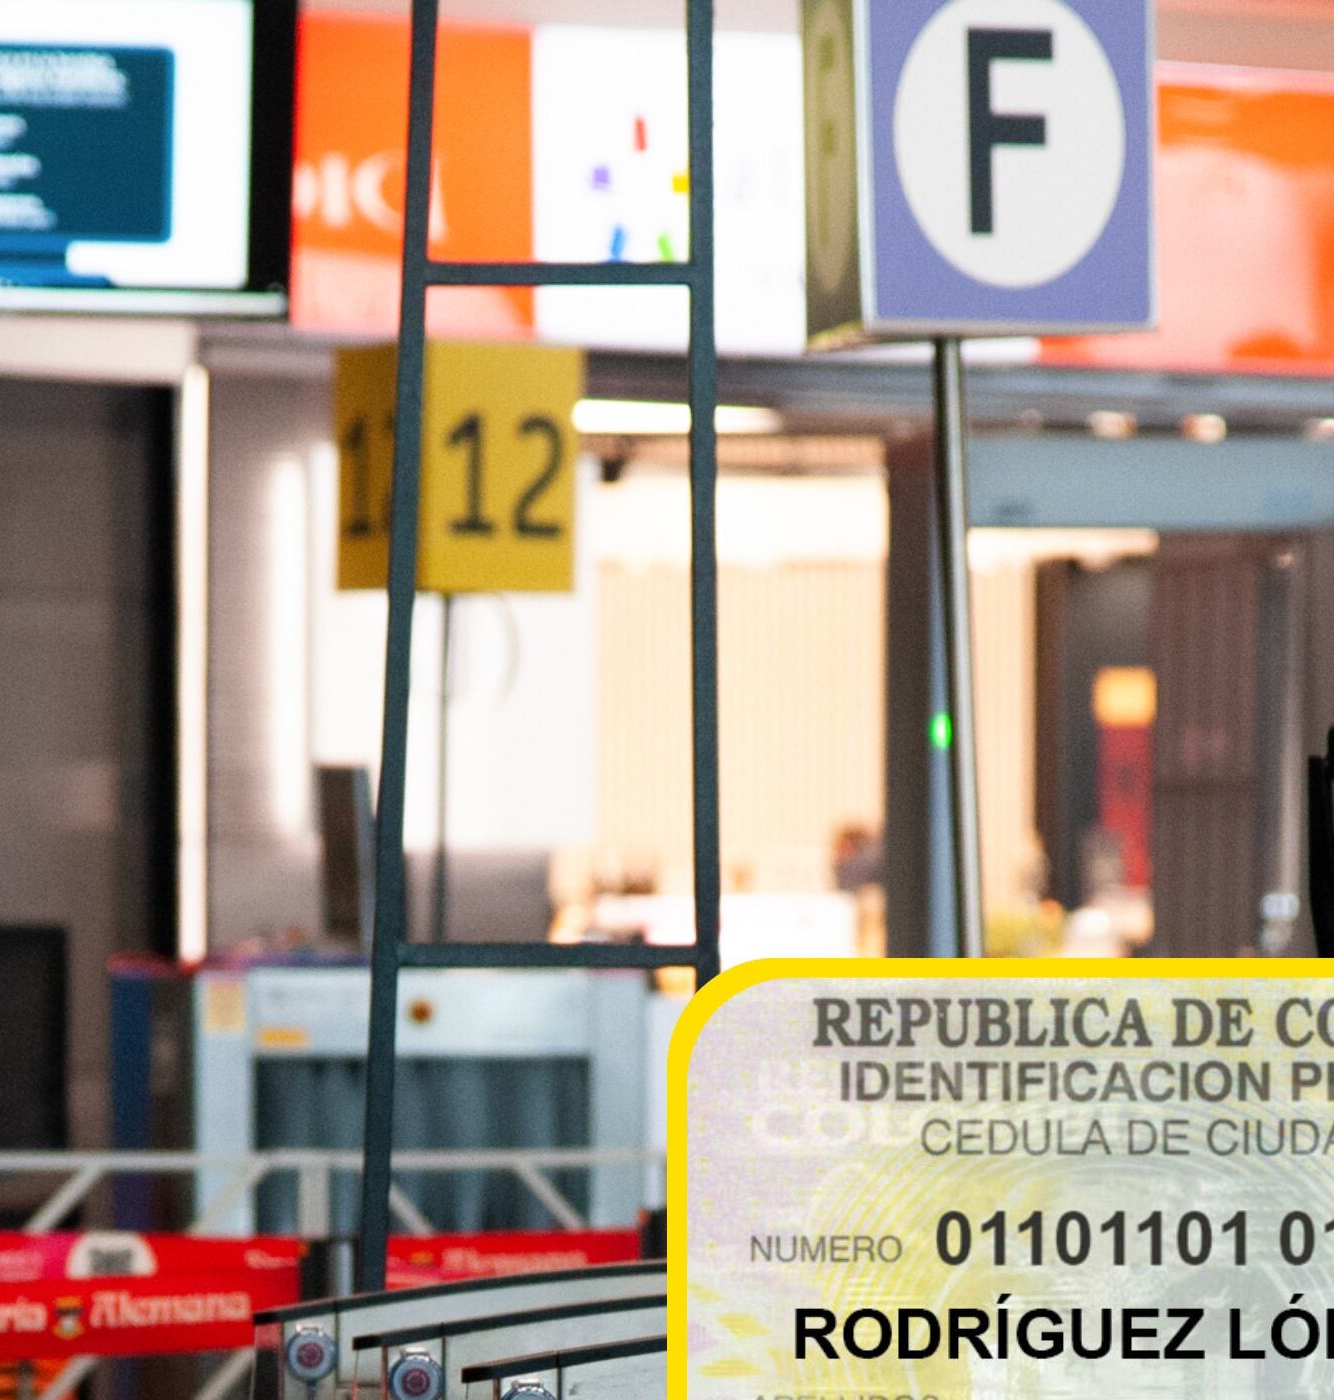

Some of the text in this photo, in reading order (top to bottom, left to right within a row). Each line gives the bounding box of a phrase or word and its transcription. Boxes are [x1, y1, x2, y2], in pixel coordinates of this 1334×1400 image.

[966, 28, 1053, 234] F
[447, 412, 562, 539] 12
[90, 1290, 252, 1328] Alemana
